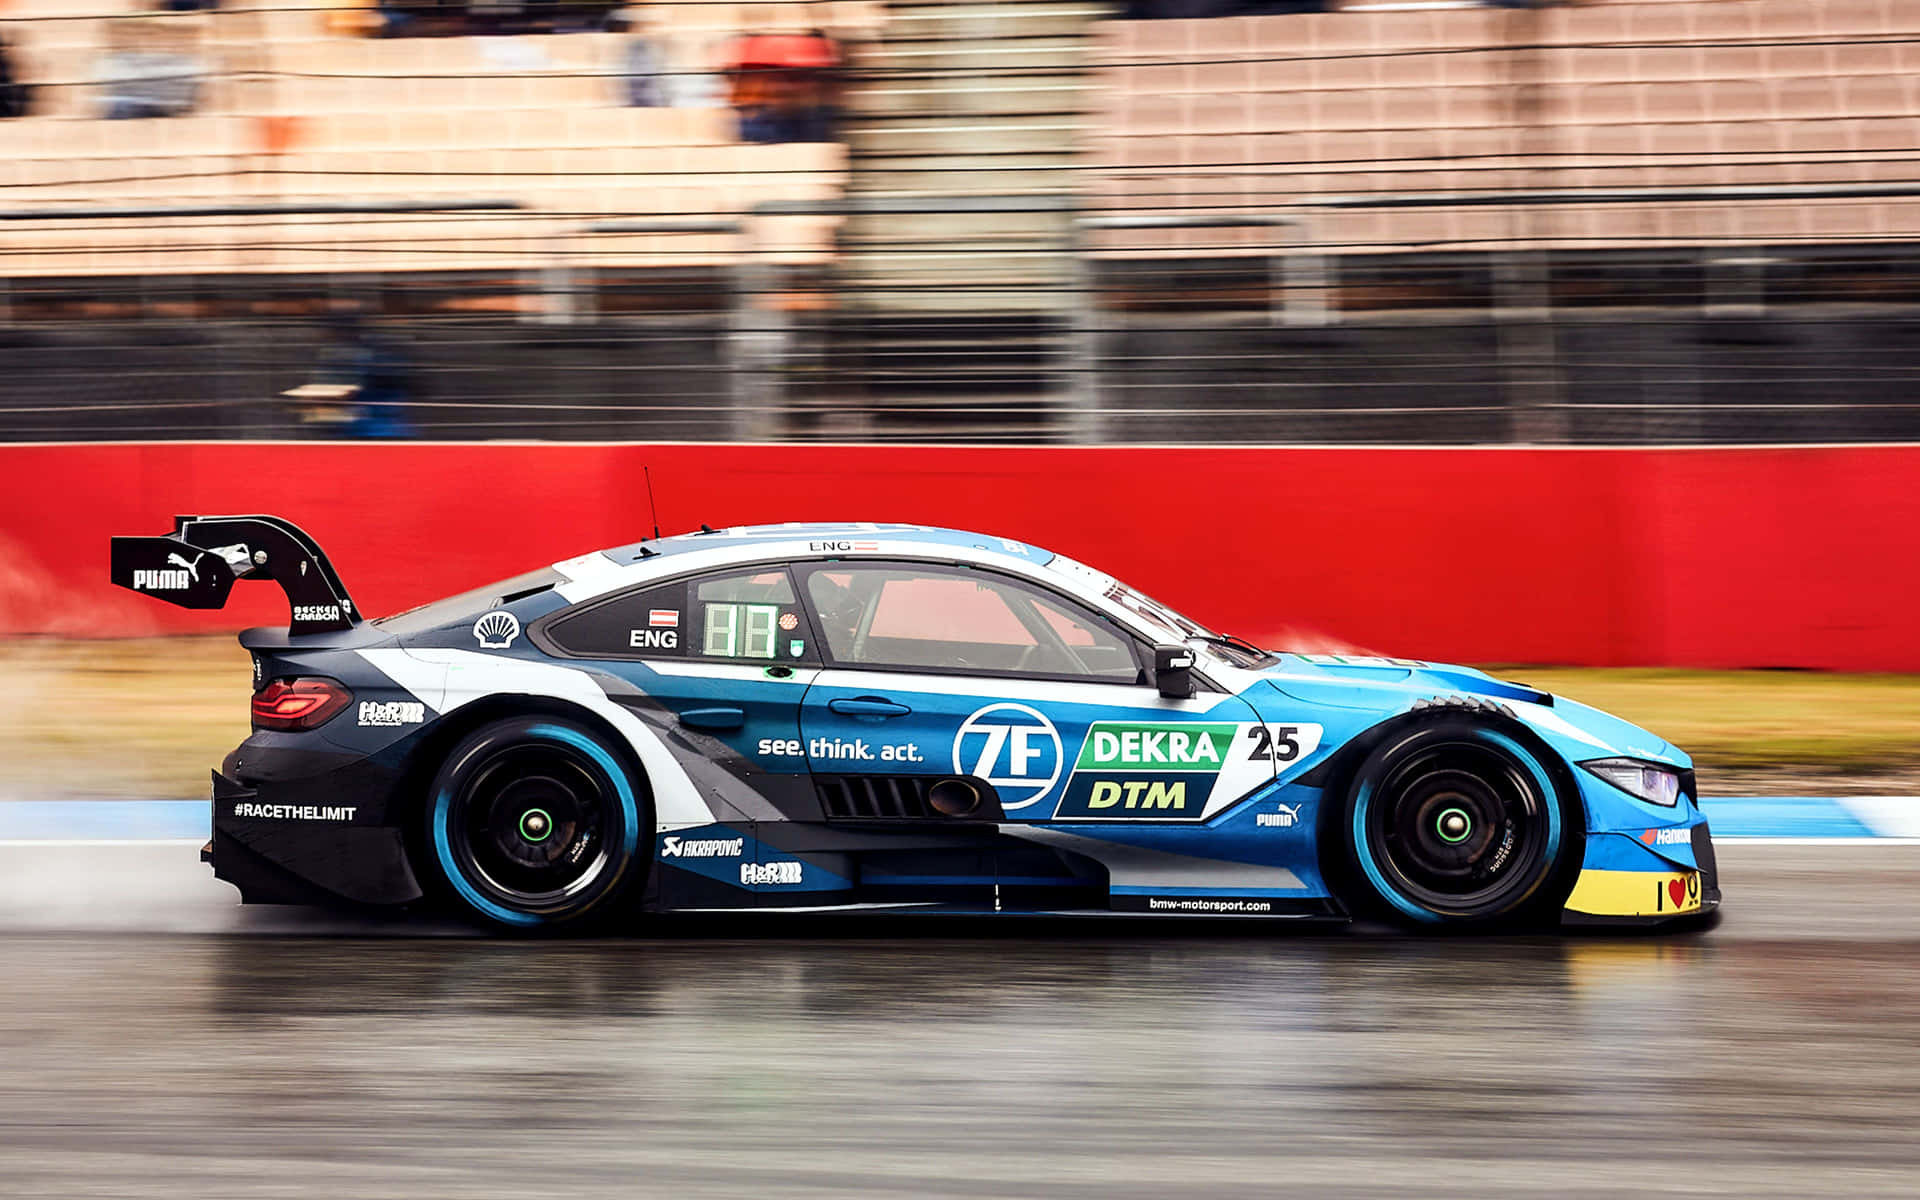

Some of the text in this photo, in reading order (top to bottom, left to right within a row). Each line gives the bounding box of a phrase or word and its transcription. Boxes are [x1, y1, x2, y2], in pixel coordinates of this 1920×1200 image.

[809, 541, 852, 552] ENG
[133, 569, 190, 590] PUMA
[629, 629, 678, 649] ENG
[757, 737, 924, 763] see. think. act.
[1093, 731, 1220, 763] DEKRA
[1247, 726, 1299, 762] 25
[961, 719, 1055, 791] ZF
[1087, 780, 1187, 810] DTM
[234, 803, 357, 821] #RACETHELIMIT
[1256, 812, 1293, 828] PUMA
[1149, 897, 1271, 912] bmw-motorsport.com
